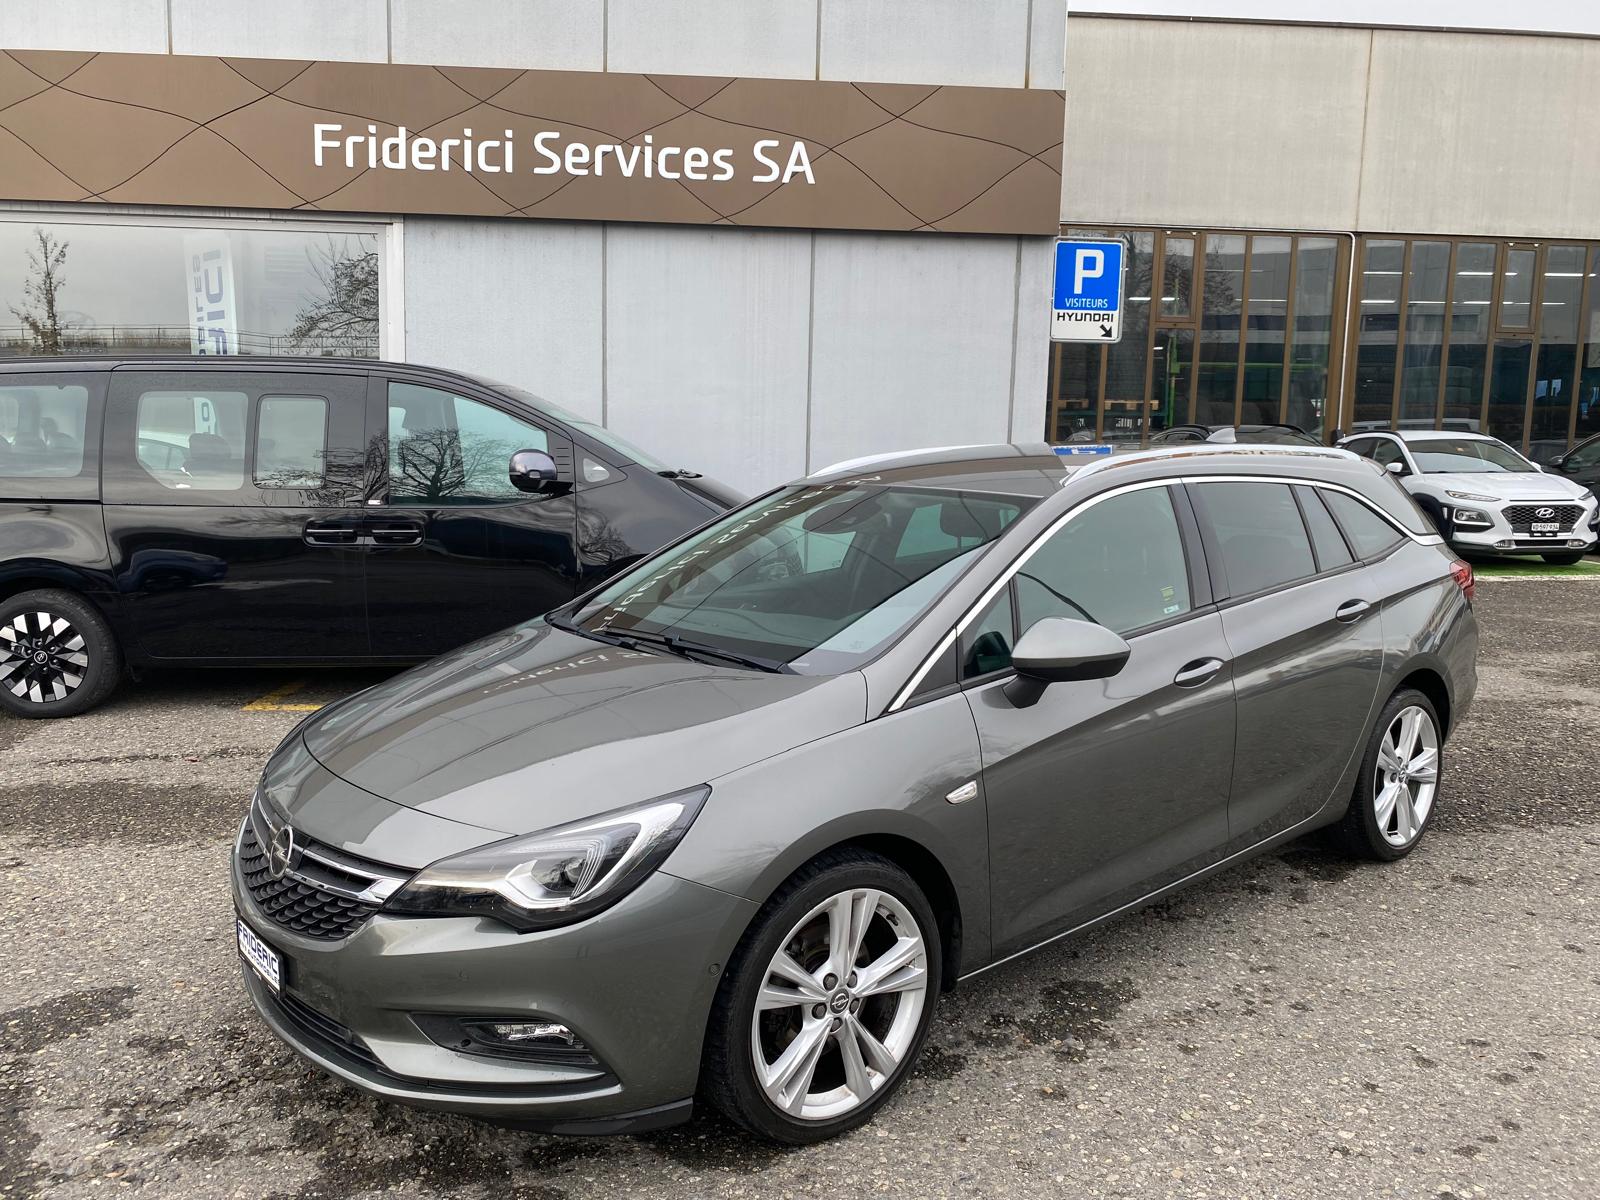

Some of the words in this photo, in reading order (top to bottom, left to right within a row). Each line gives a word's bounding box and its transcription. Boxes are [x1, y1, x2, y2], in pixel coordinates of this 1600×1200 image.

[313, 123, 514, 173] Friderici
[533, 131, 734, 182] Services
[752, 139, 816, 184] SA
[1074, 249, 1104, 294] P
[1057, 312, 1114, 323] HYUNDAI
[1065, 298, 1108, 309] VISITEURS
